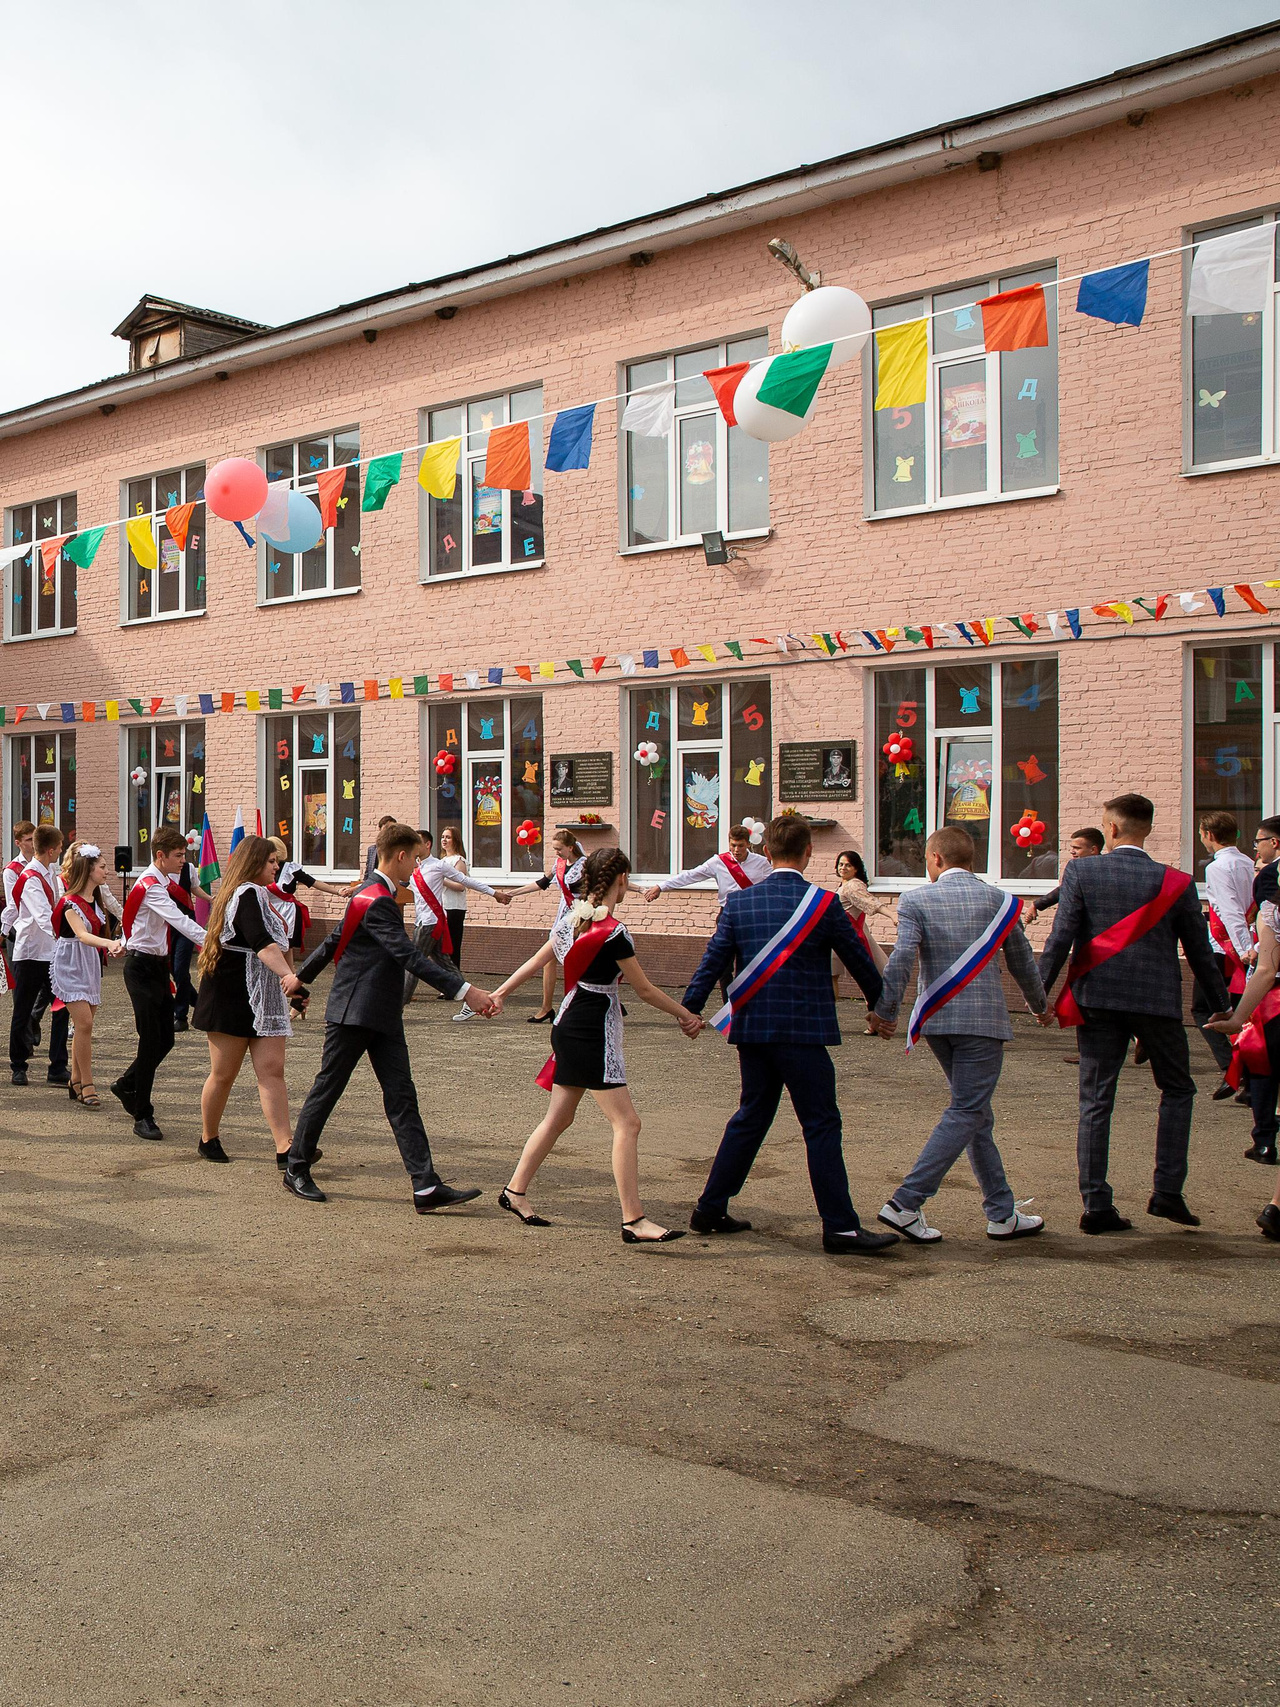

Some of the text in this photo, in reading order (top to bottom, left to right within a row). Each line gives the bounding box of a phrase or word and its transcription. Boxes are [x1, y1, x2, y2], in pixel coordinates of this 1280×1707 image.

[1018, 378, 1038, 400] Д
[136, 502, 144, 516] Б
[190, 534, 200, 550] Е
[443, 533, 457, 554] Д
[524, 537, 536, 557] Е
[140, 579, 149, 595] Д
[197, 576, 206, 591] Г
[1017, 684, 1040, 712] 4
[1234, 679, 1255, 703] А
[645, 711, 660, 731] Д
[742, 704, 764, 731] 5
[896, 701, 918, 728] 5
[446, 729, 458, 747] Д
[523, 719, 538, 741] 4
[141, 746, 148, 760] А
[192, 742, 204, 760] 4
[277, 739, 289, 760] 5
[342, 740, 356, 760] 4
[1215, 746, 1242, 777] 5
[279, 775, 290, 791] Б
[68, 799, 75, 812] Е
[278, 820, 289, 837] Е
[342, 817, 353, 835] Д
[650, 809, 666, 830] Е
[903, 808, 924, 835] 4
[139, 828, 148, 843] В
